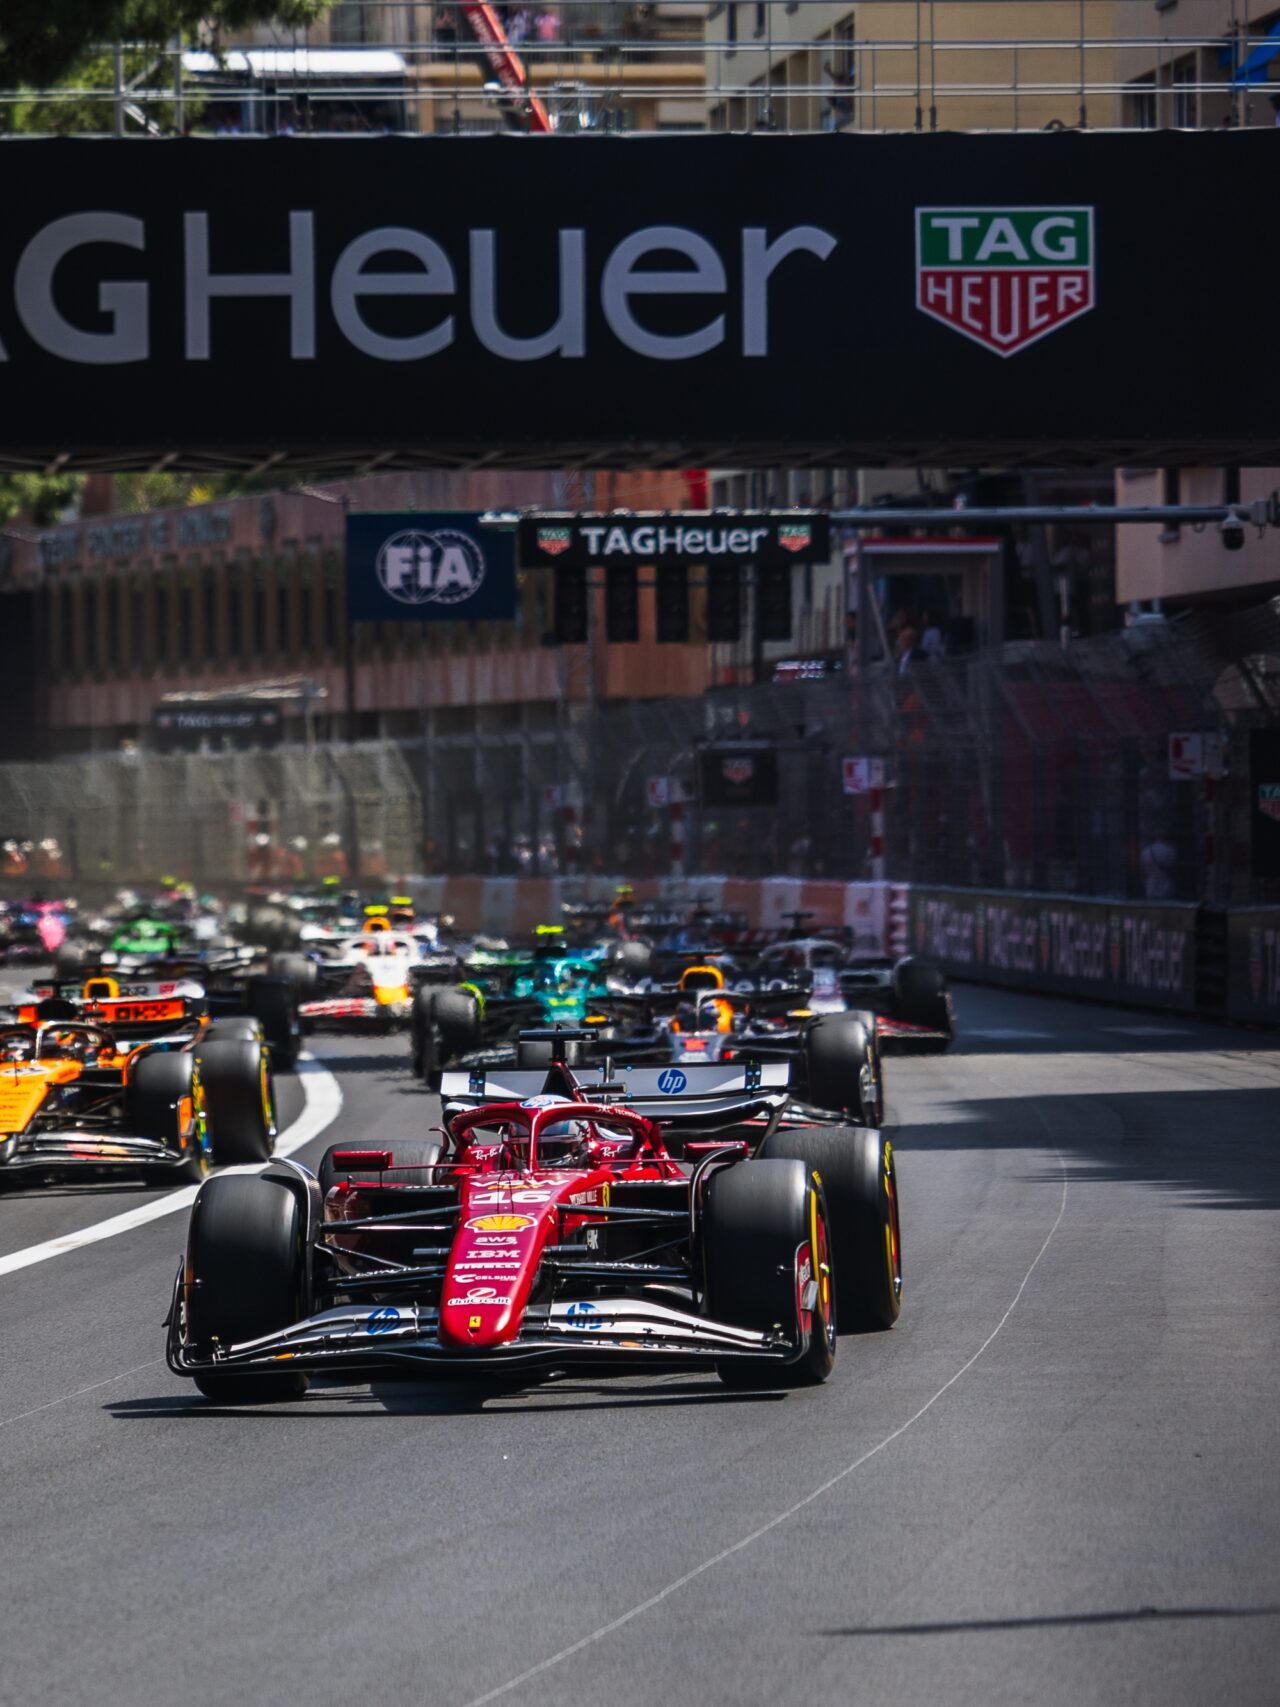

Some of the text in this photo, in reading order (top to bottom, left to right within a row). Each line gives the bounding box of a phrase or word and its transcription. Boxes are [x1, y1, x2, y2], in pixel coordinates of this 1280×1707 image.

[931, 216, 1076, 261] TAG
[927, 276, 1083, 344] HEUER
[660, 1069, 686, 1095] hp
[472, 1190, 553, 1205] 16
[466, 1250, 521, 1259] IBM
[454, 1262, 522, 1270] PIRELLI
